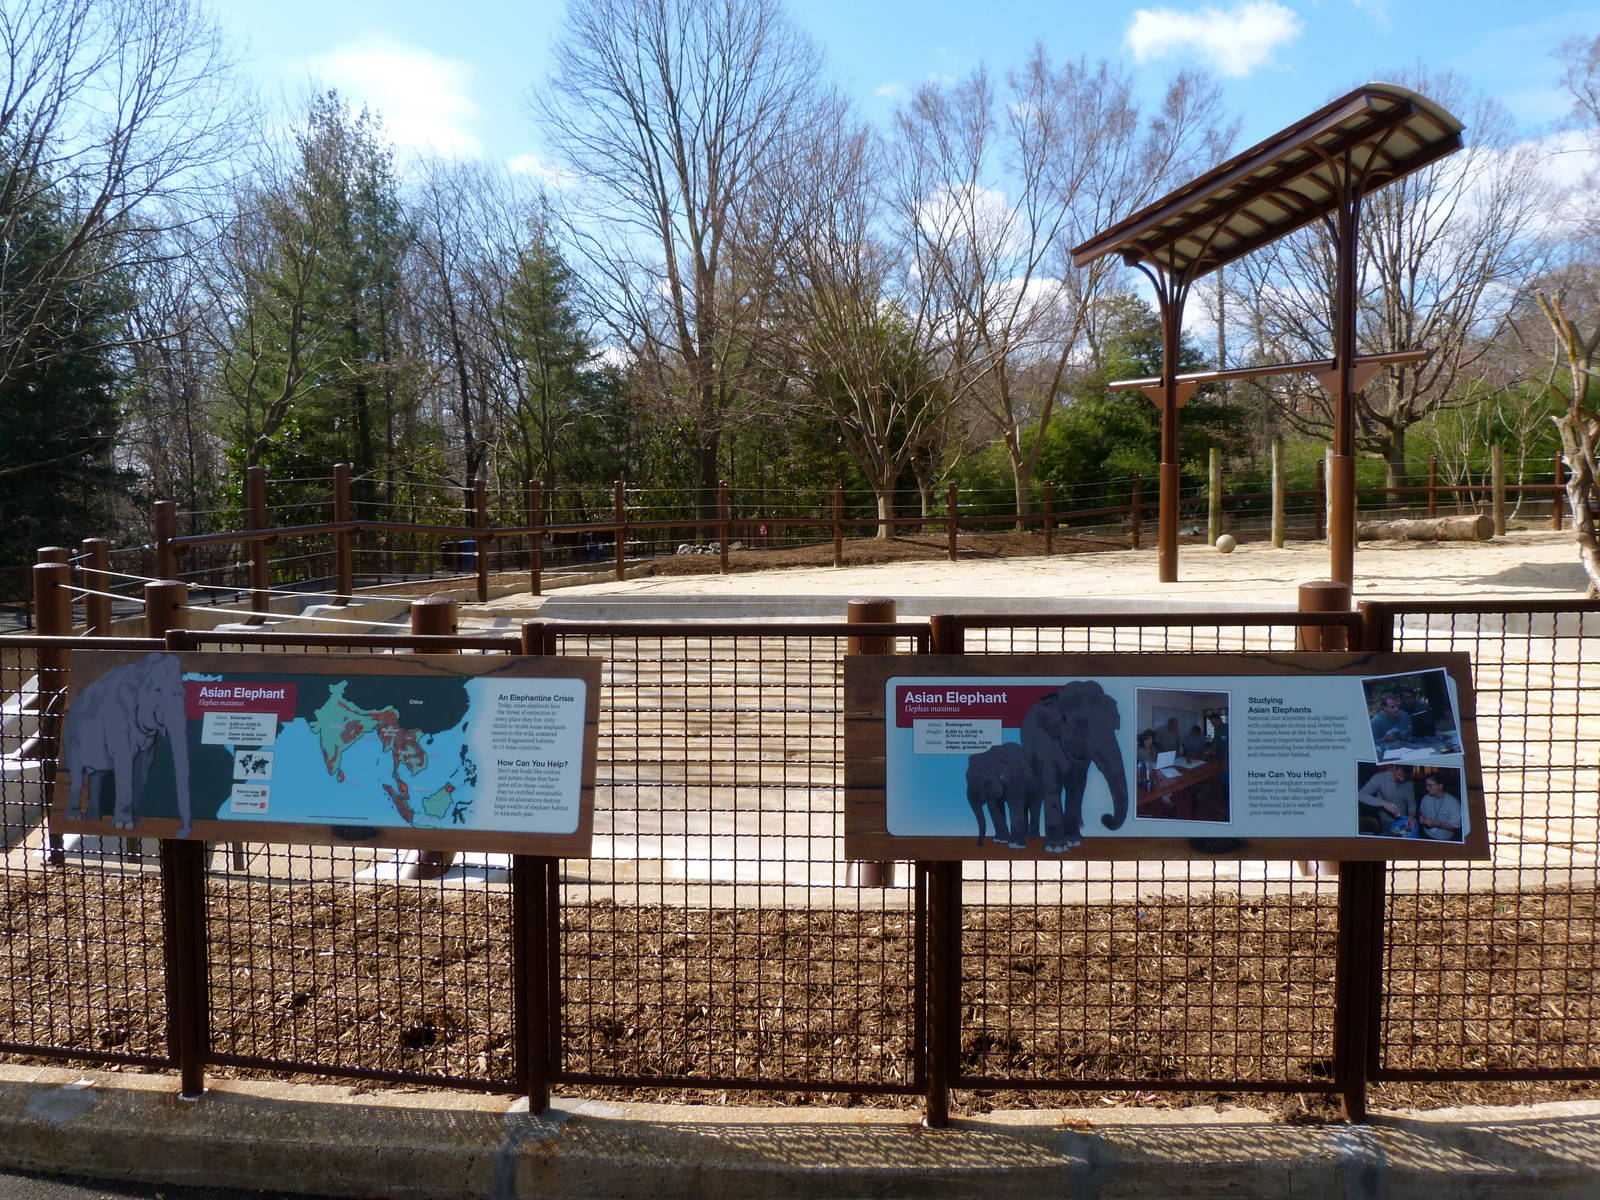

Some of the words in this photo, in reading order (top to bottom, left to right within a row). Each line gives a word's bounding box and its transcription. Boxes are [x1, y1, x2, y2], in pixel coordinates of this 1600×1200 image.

[200, 687, 231, 697] Asian
[233, 688, 285, 700] Elephant
[510, 694, 551, 703] Elephantine
[904, 692, 942, 703] Asian
[946, 692, 1007, 706] Elephant
[1248, 697, 1283, 705] Studying
[905, 705, 929, 714] Elephas
[1304, 771, 1326, 779] Help?
